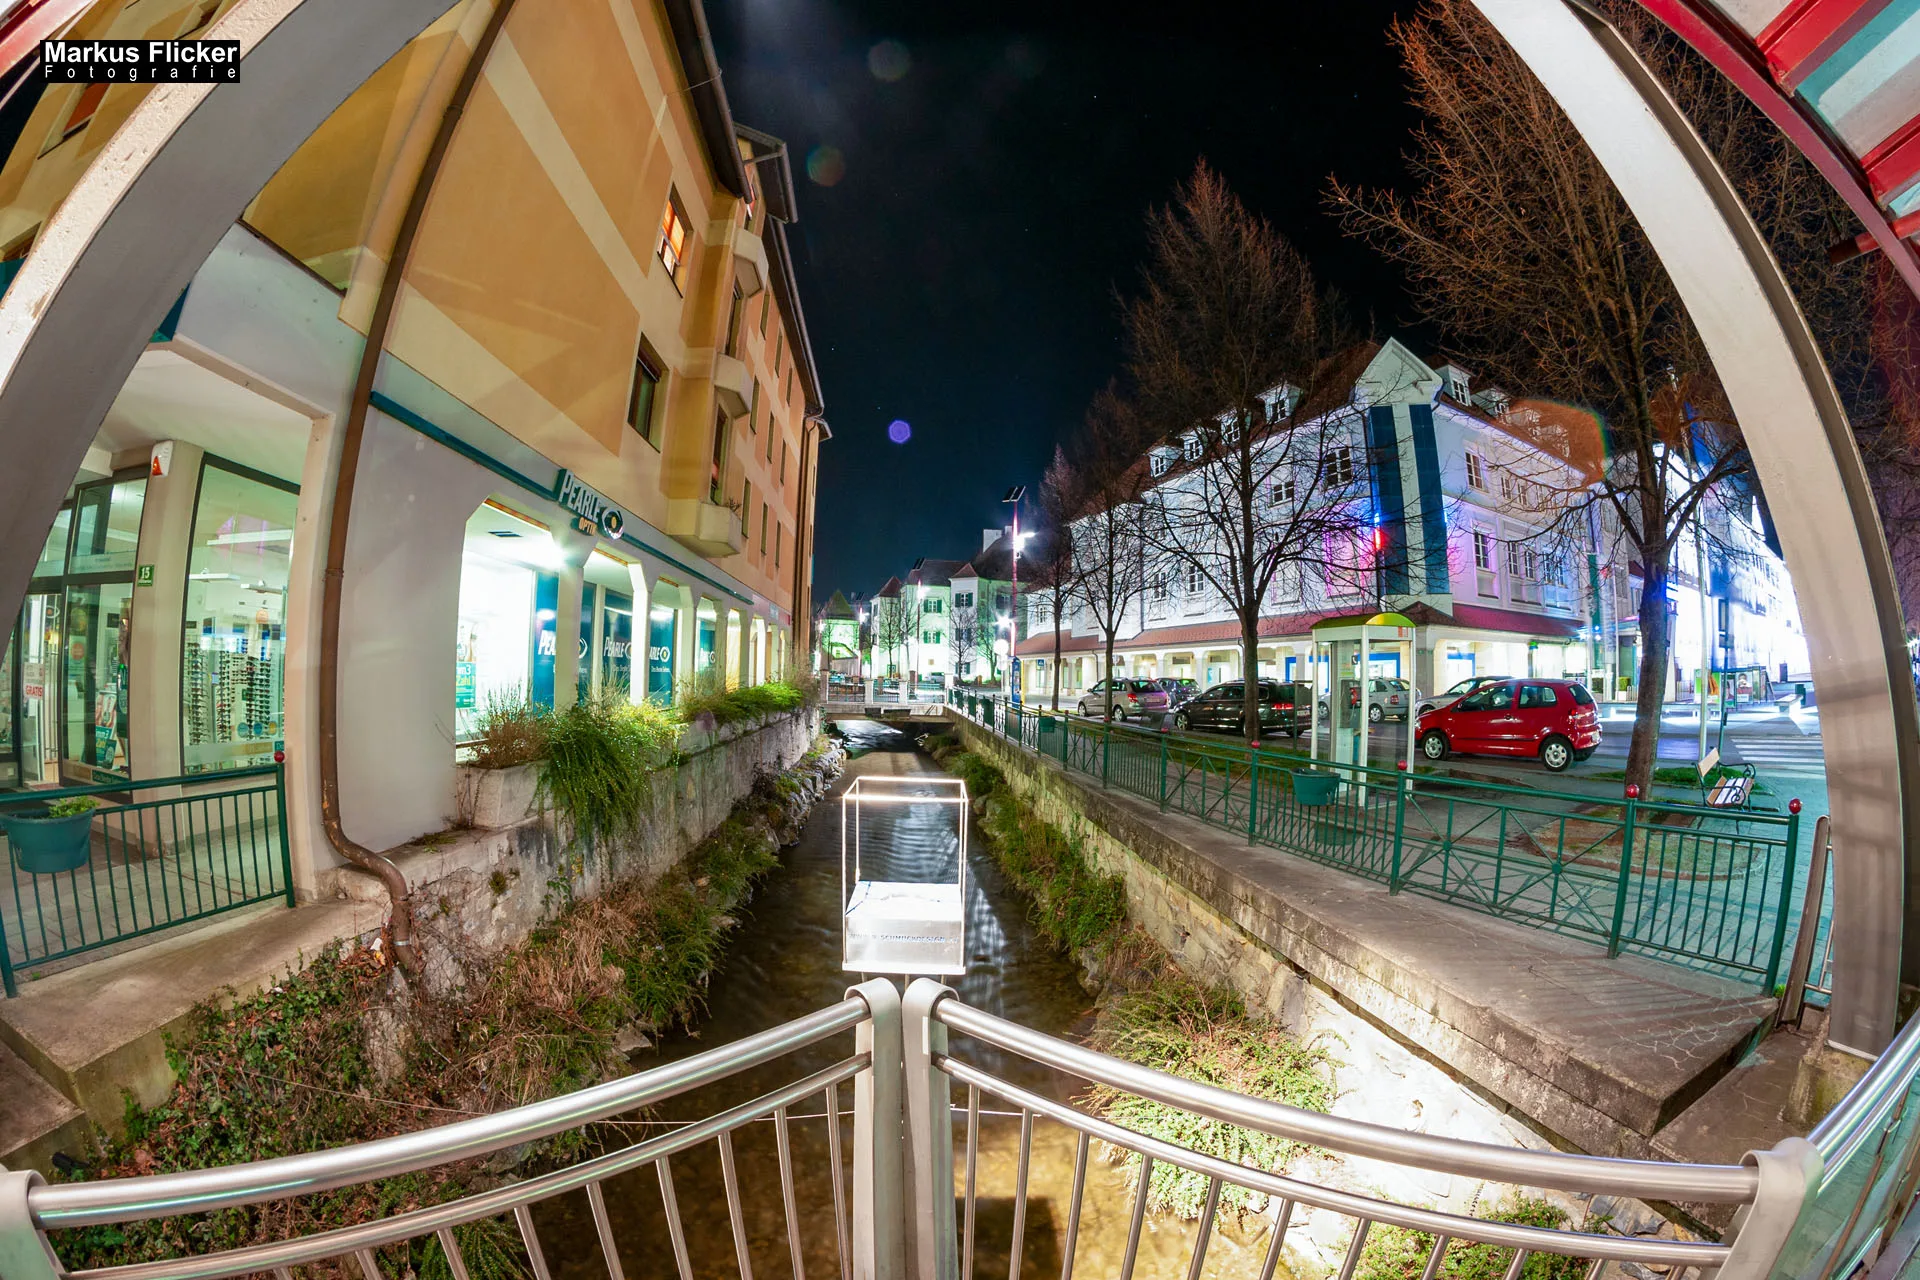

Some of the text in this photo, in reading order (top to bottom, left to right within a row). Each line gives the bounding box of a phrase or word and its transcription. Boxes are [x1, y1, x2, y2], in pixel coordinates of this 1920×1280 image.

[559, 470, 600, 523] PEARLE
[141, 566, 151, 579] 15
[537, 630, 557, 655] PEA
[603, 636, 625, 658] PEARLE
[25, 684, 43, 697] GRATIS
